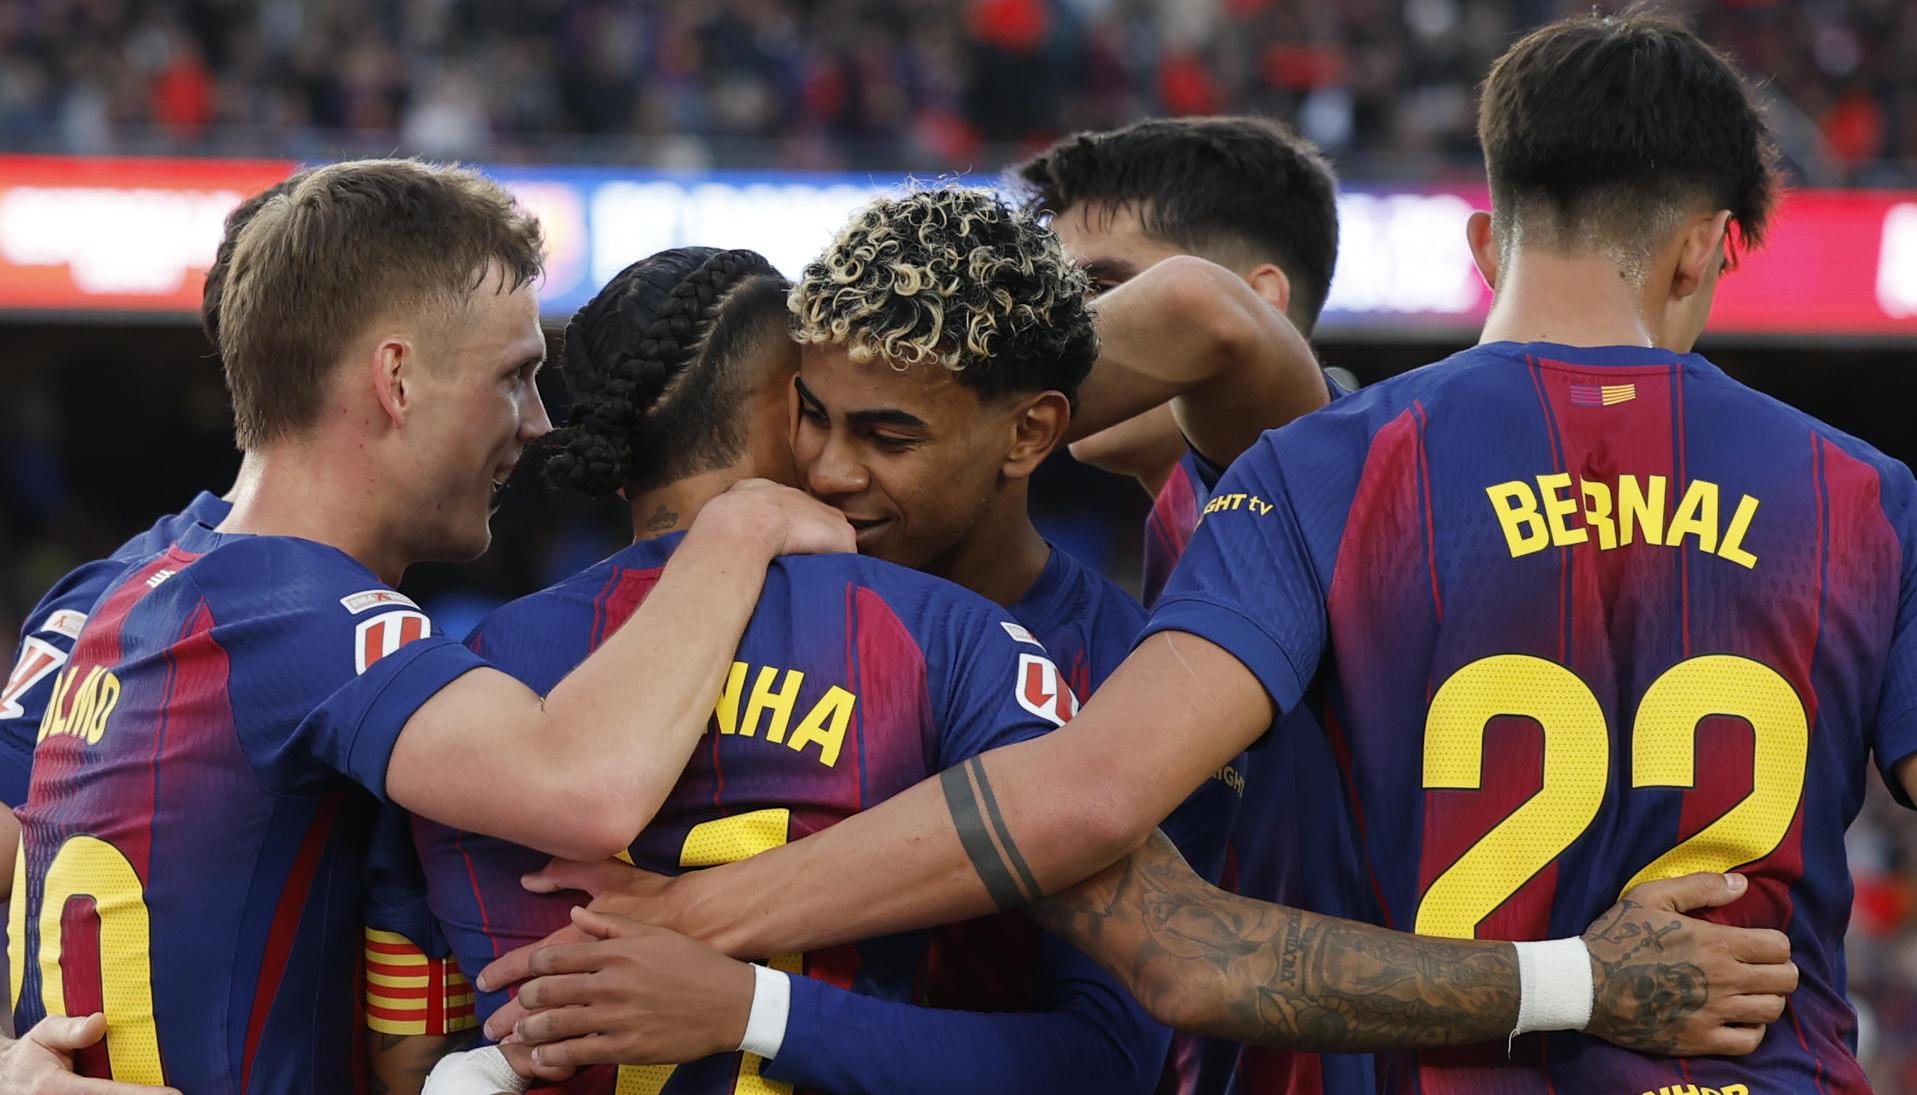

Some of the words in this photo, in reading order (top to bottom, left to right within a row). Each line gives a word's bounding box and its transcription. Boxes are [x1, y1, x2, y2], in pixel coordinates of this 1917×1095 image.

[1248, 495, 1274, 516] tv
[1485, 472, 1760, 569] BERNAL
[702, 661, 856, 768] NHA
[1414, 653, 1809, 940] 22
[7, 831, 165, 1087] 0
